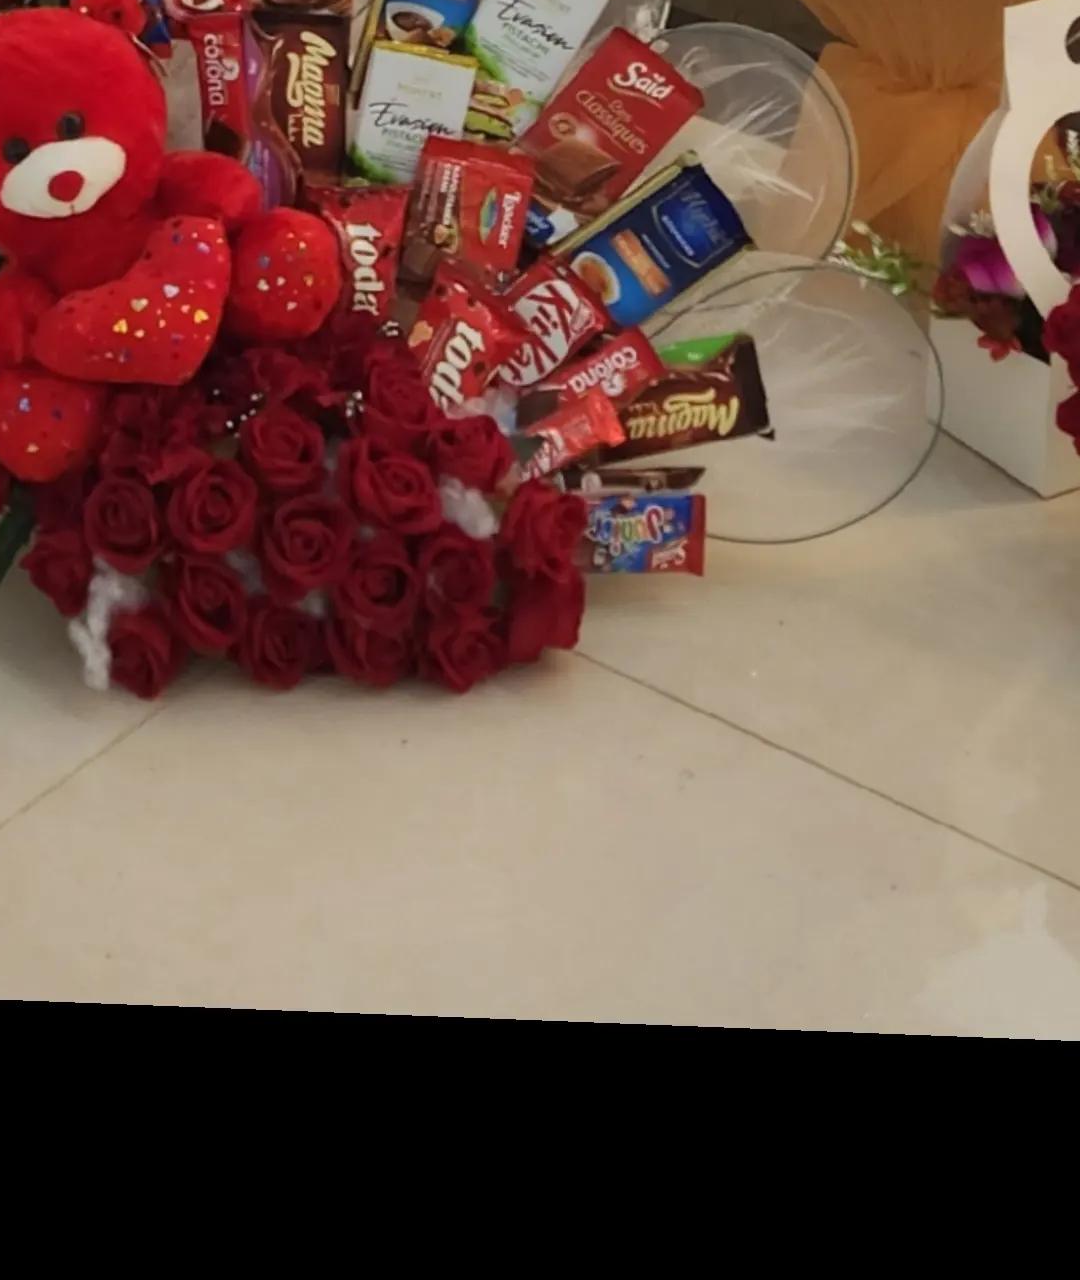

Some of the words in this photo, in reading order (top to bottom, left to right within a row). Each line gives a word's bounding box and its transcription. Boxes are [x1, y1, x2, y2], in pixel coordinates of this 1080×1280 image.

[203, 32, 225, 107] corona
[576, 89, 649, 156] Classiques
[345, 222, 385, 314] toda
[567, 346, 637, 394] corona
